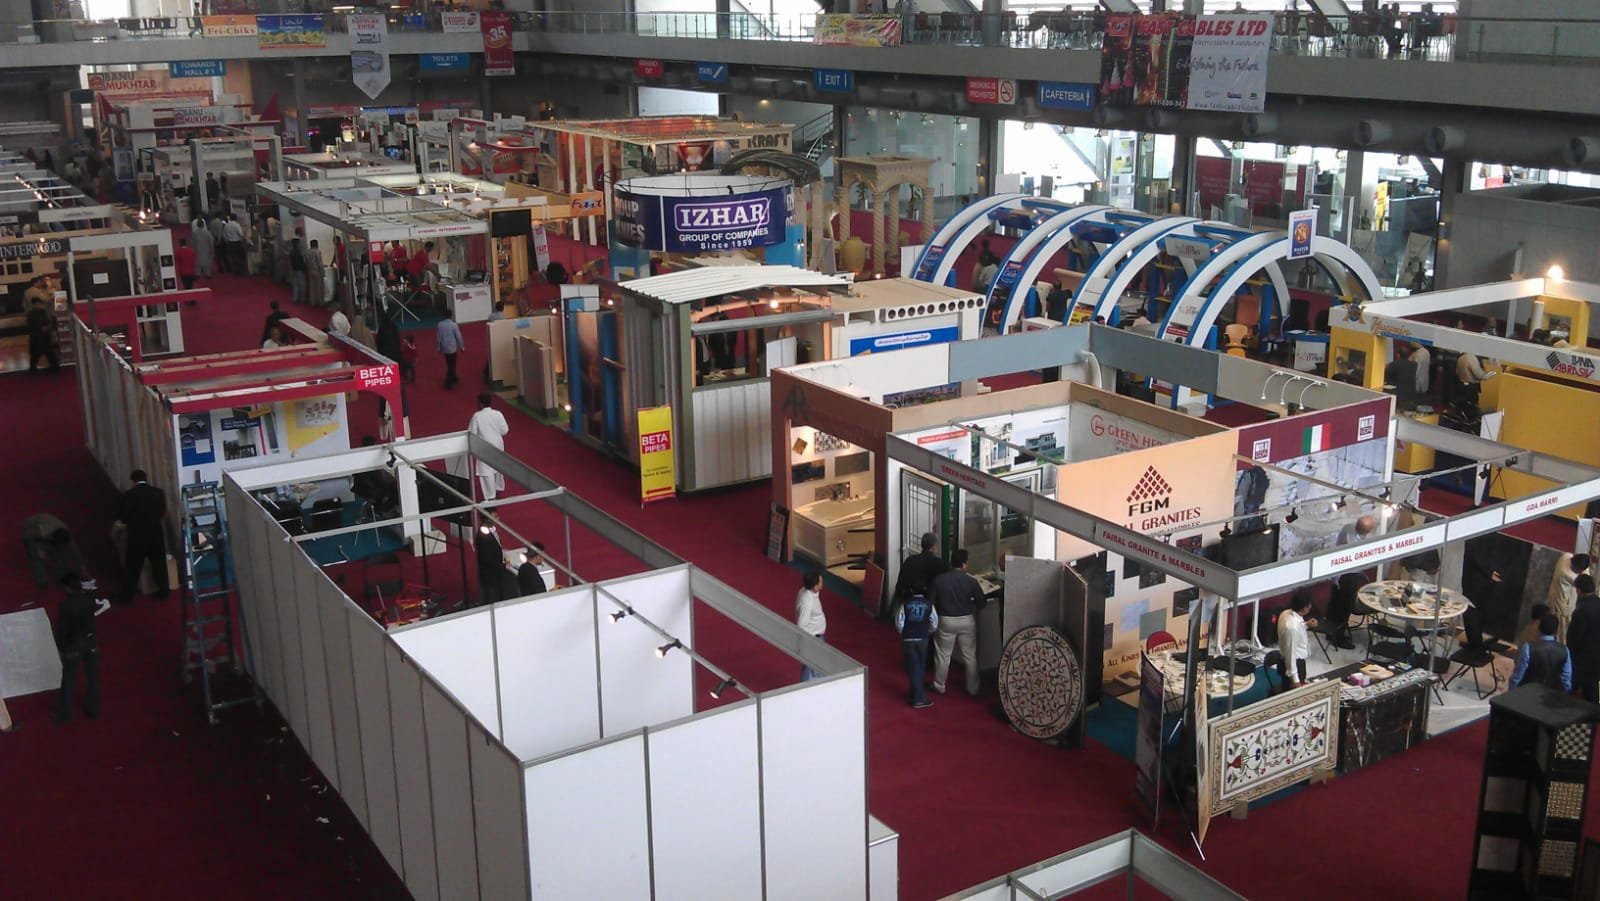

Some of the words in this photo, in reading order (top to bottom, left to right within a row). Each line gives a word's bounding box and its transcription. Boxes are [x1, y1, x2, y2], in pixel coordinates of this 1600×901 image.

[490, 25, 507, 42] 35
[1137, 20, 1175, 35] FAST
[1177, 20, 1234, 36] CABLES
[1236, 20, 1268, 36] LTD
[104, 71, 135, 80] BANU
[825, 75, 840, 85] EXIT
[105, 80, 157, 90] MUKHTAR
[1045, 89, 1085, 102] CAFETERIA
[184, 108, 203, 116] BANU
[184, 115, 217, 123] MUKHTAR
[681, 203, 765, 226] IZHAR
[679, 233, 710, 243] GROUP
[712, 232, 723, 241] OF
[725, 227, 769, 241] COMPANIES
[0, 241, 61, 257] INTERWOOD
[701, 241, 729, 250] Since
[732, 240, 752, 248] 1959
[359, 365, 395, 380] BETA
[364, 377, 392, 388] PIPES
[641, 433, 669, 446] BETA
[1108, 424, 1138, 444] GREEN
[644, 443, 667, 454] PIPES
[1128, 496, 1170, 517] FGM
[1142, 506, 1201, 531] GRANITES
[1103, 530, 1126, 549] FAISAL
[1127, 539, 1160, 561] GRANITE
[1168, 556, 1206, 578] MARBLES
[1331, 555, 1353, 567] FAISAL
[1354, 545, 1386, 562] GRANITES
[1395, 536, 1425, 549] MARBLES
